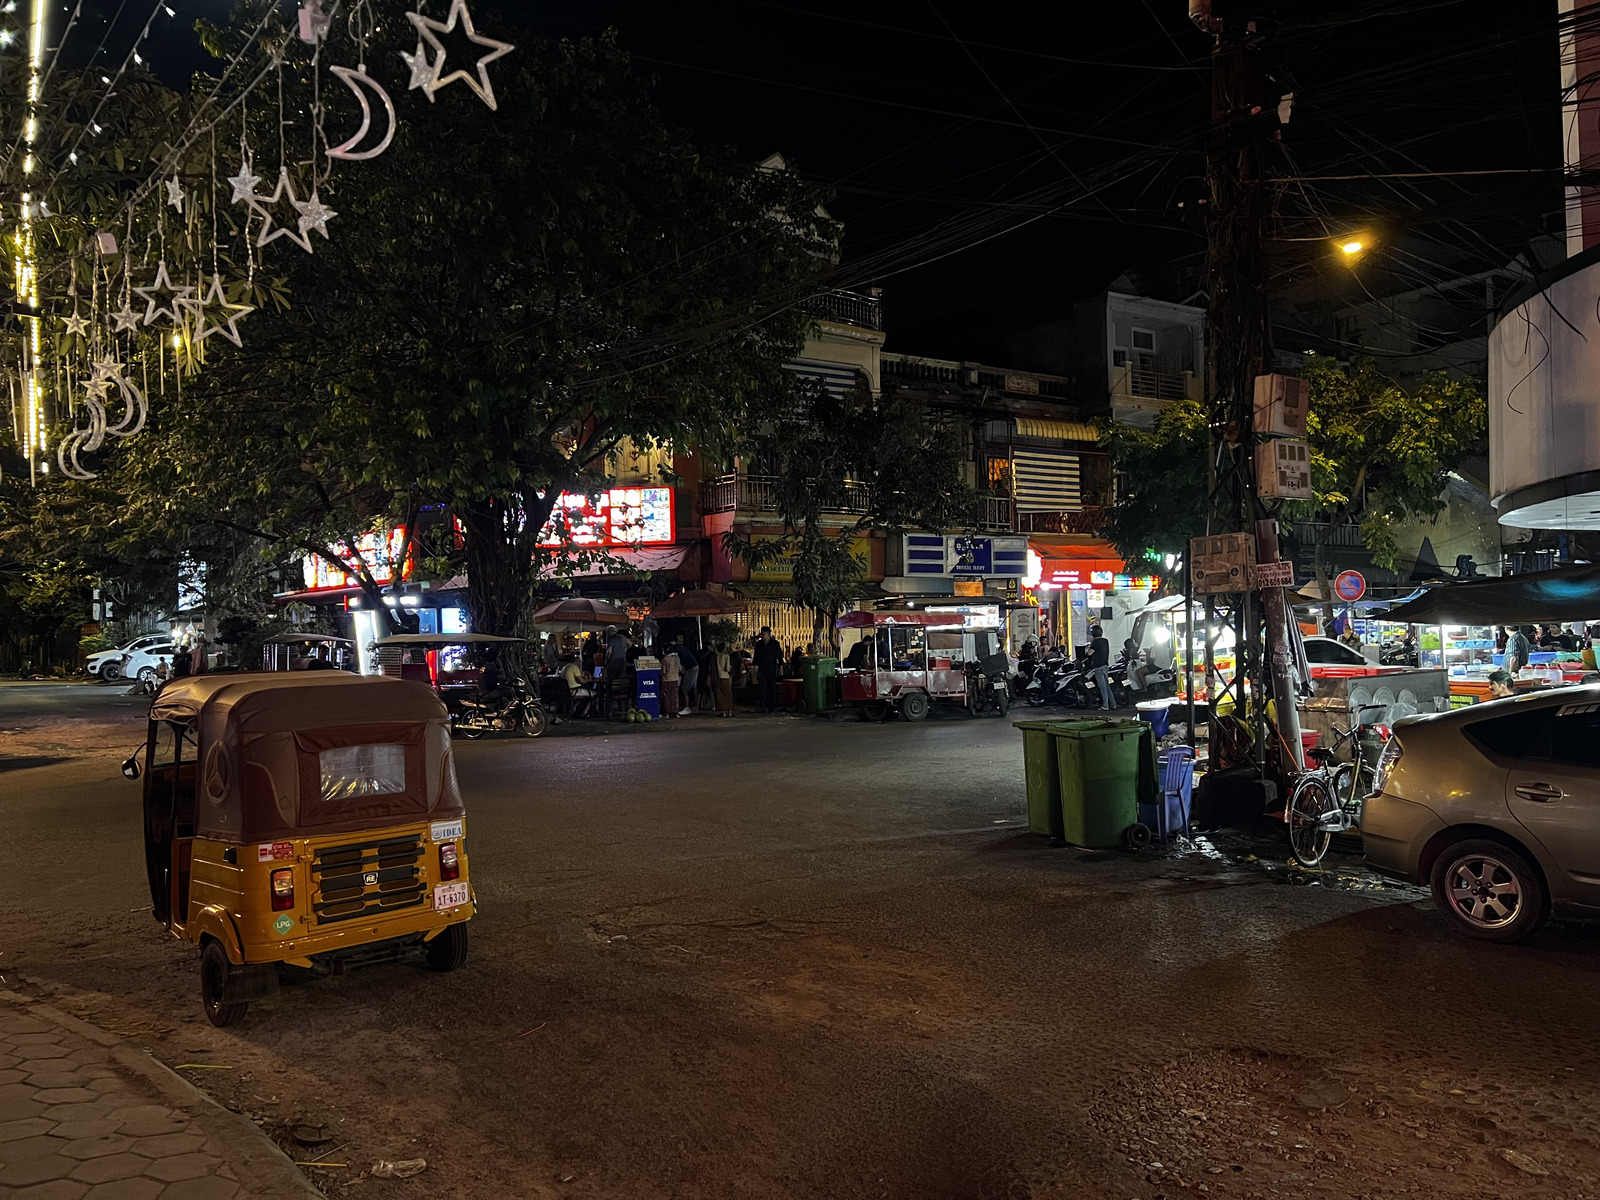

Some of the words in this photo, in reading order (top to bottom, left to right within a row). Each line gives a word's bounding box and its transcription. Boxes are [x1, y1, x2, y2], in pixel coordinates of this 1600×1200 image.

[1259, 579, 1269, 587] 012
[442, 827, 462, 837] IDEA
[276, 920, 291, 929] LPG
